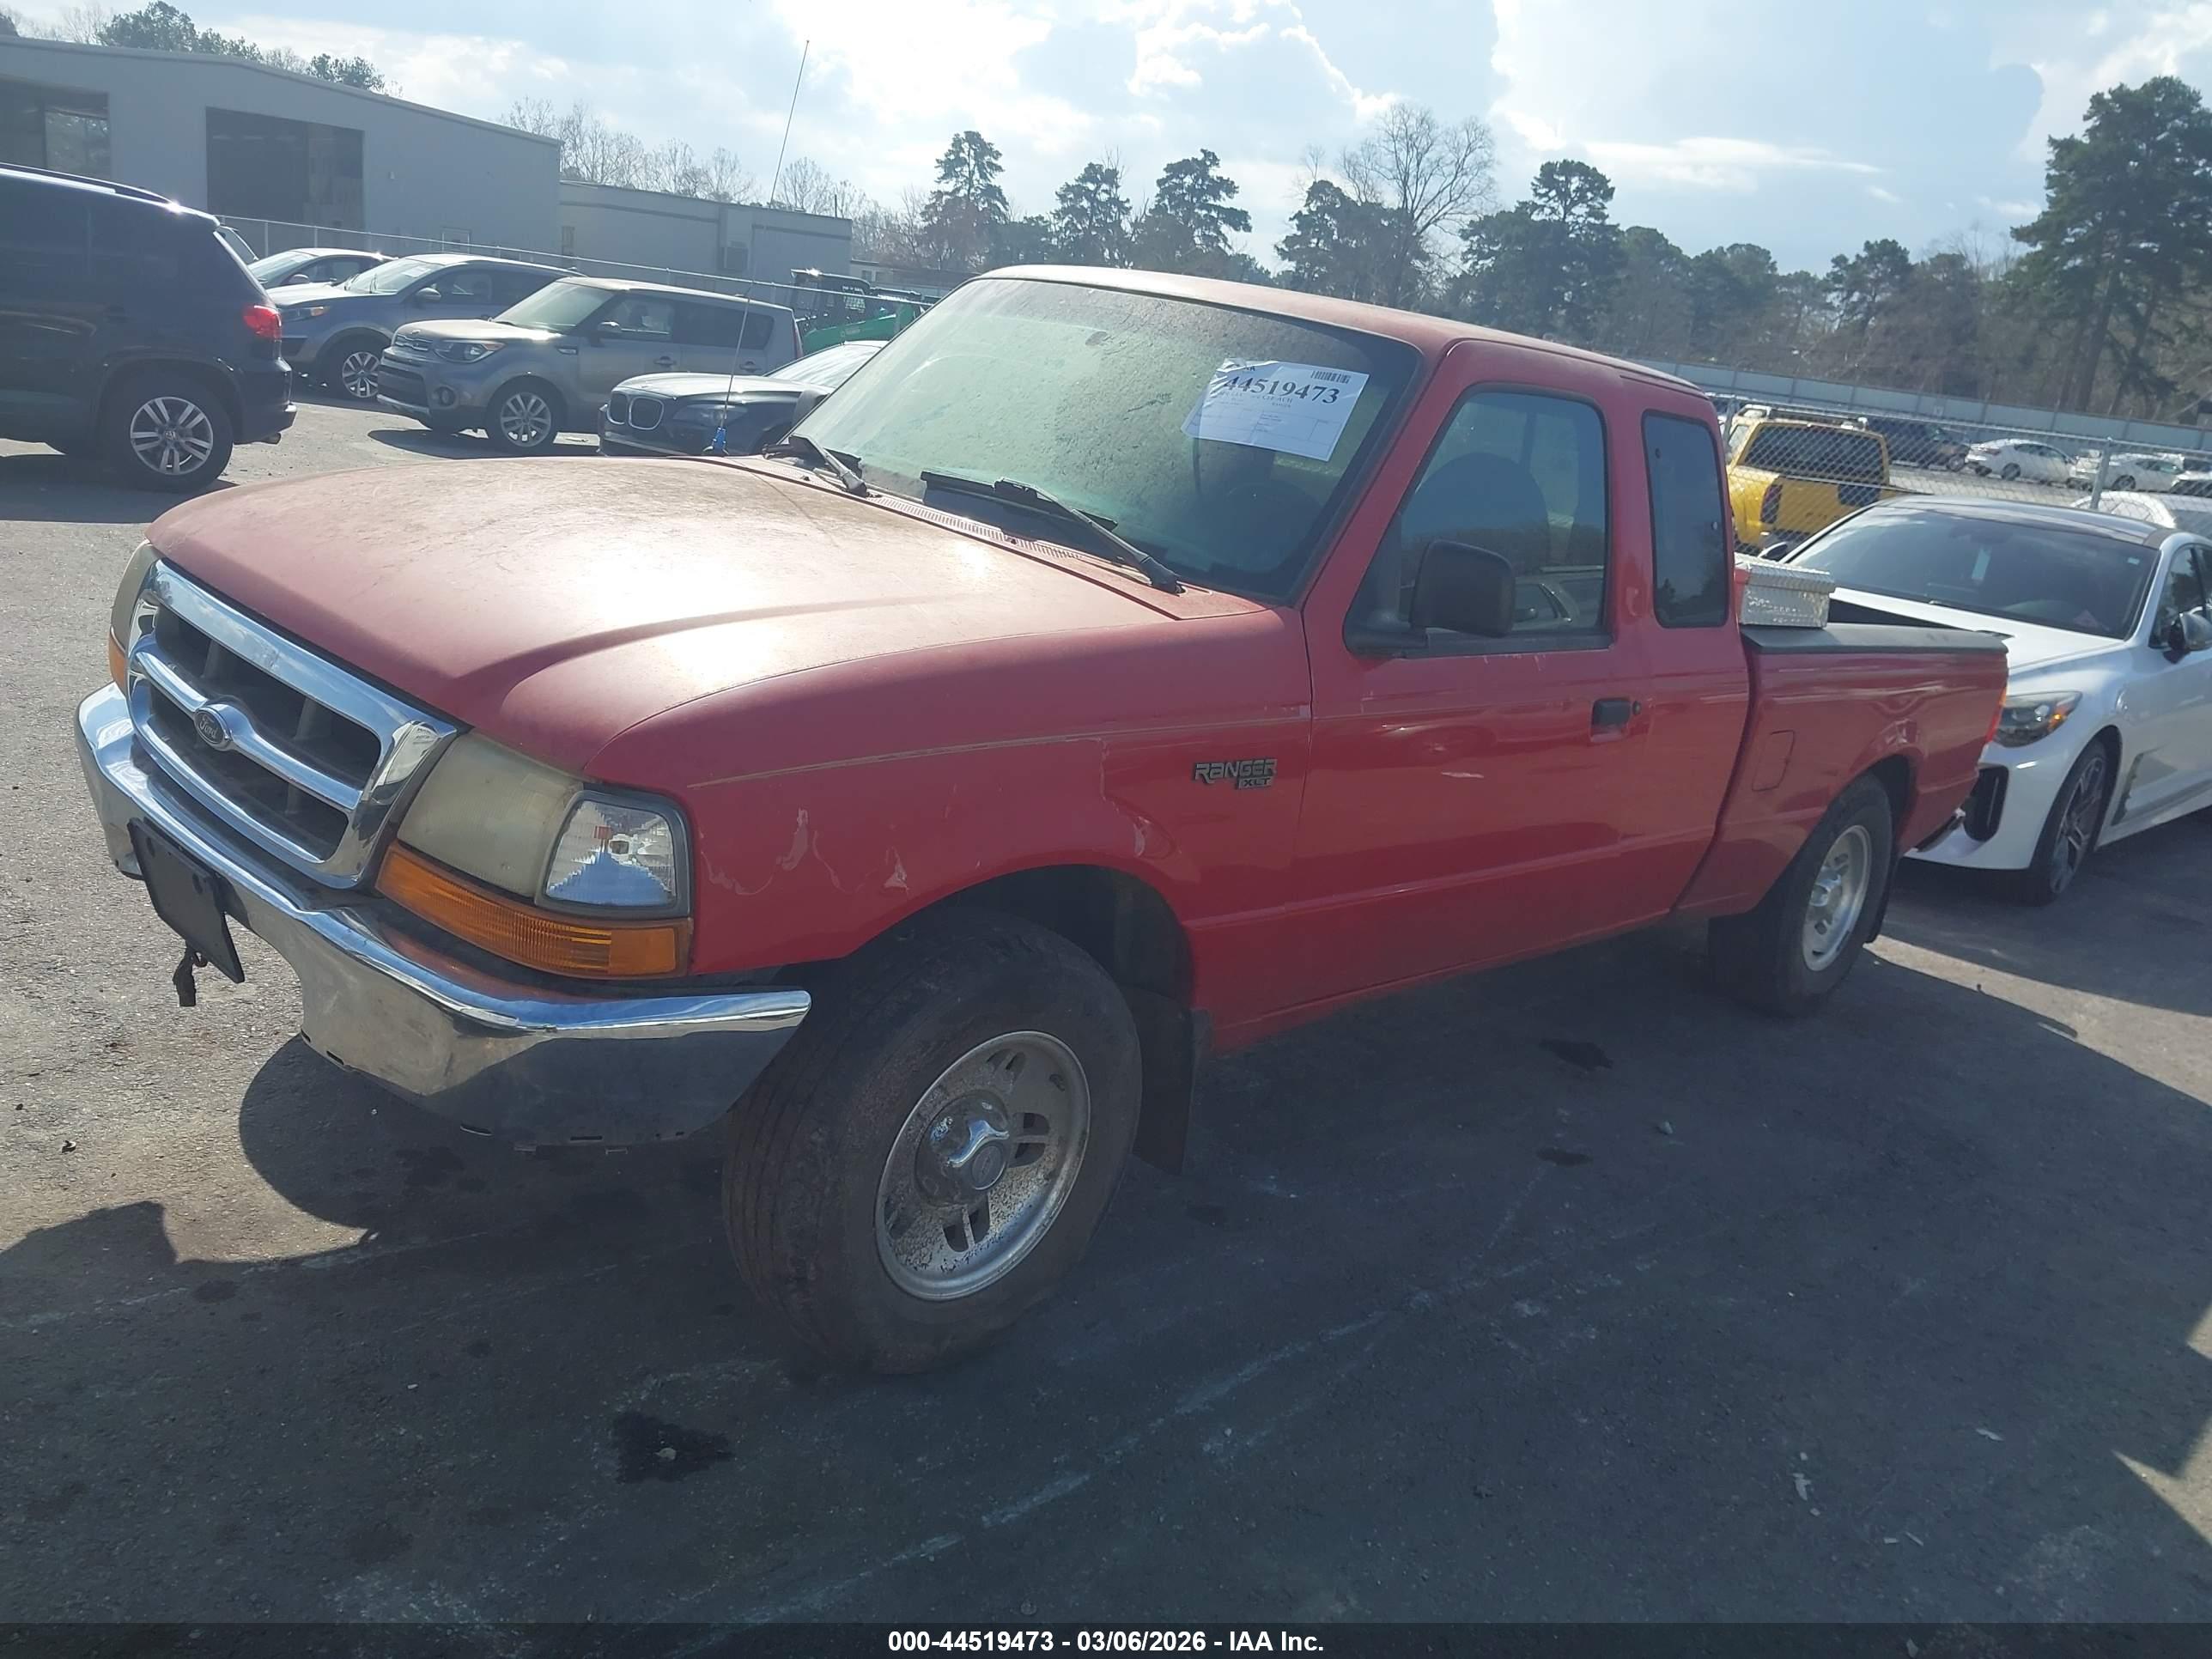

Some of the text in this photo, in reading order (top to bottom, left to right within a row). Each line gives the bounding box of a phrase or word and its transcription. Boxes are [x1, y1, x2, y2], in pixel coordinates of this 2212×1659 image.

[1223, 376, 1340, 404] 44519473
[1194, 758, 1278, 784] RANGER
[1243, 777, 1272, 787] XLT
